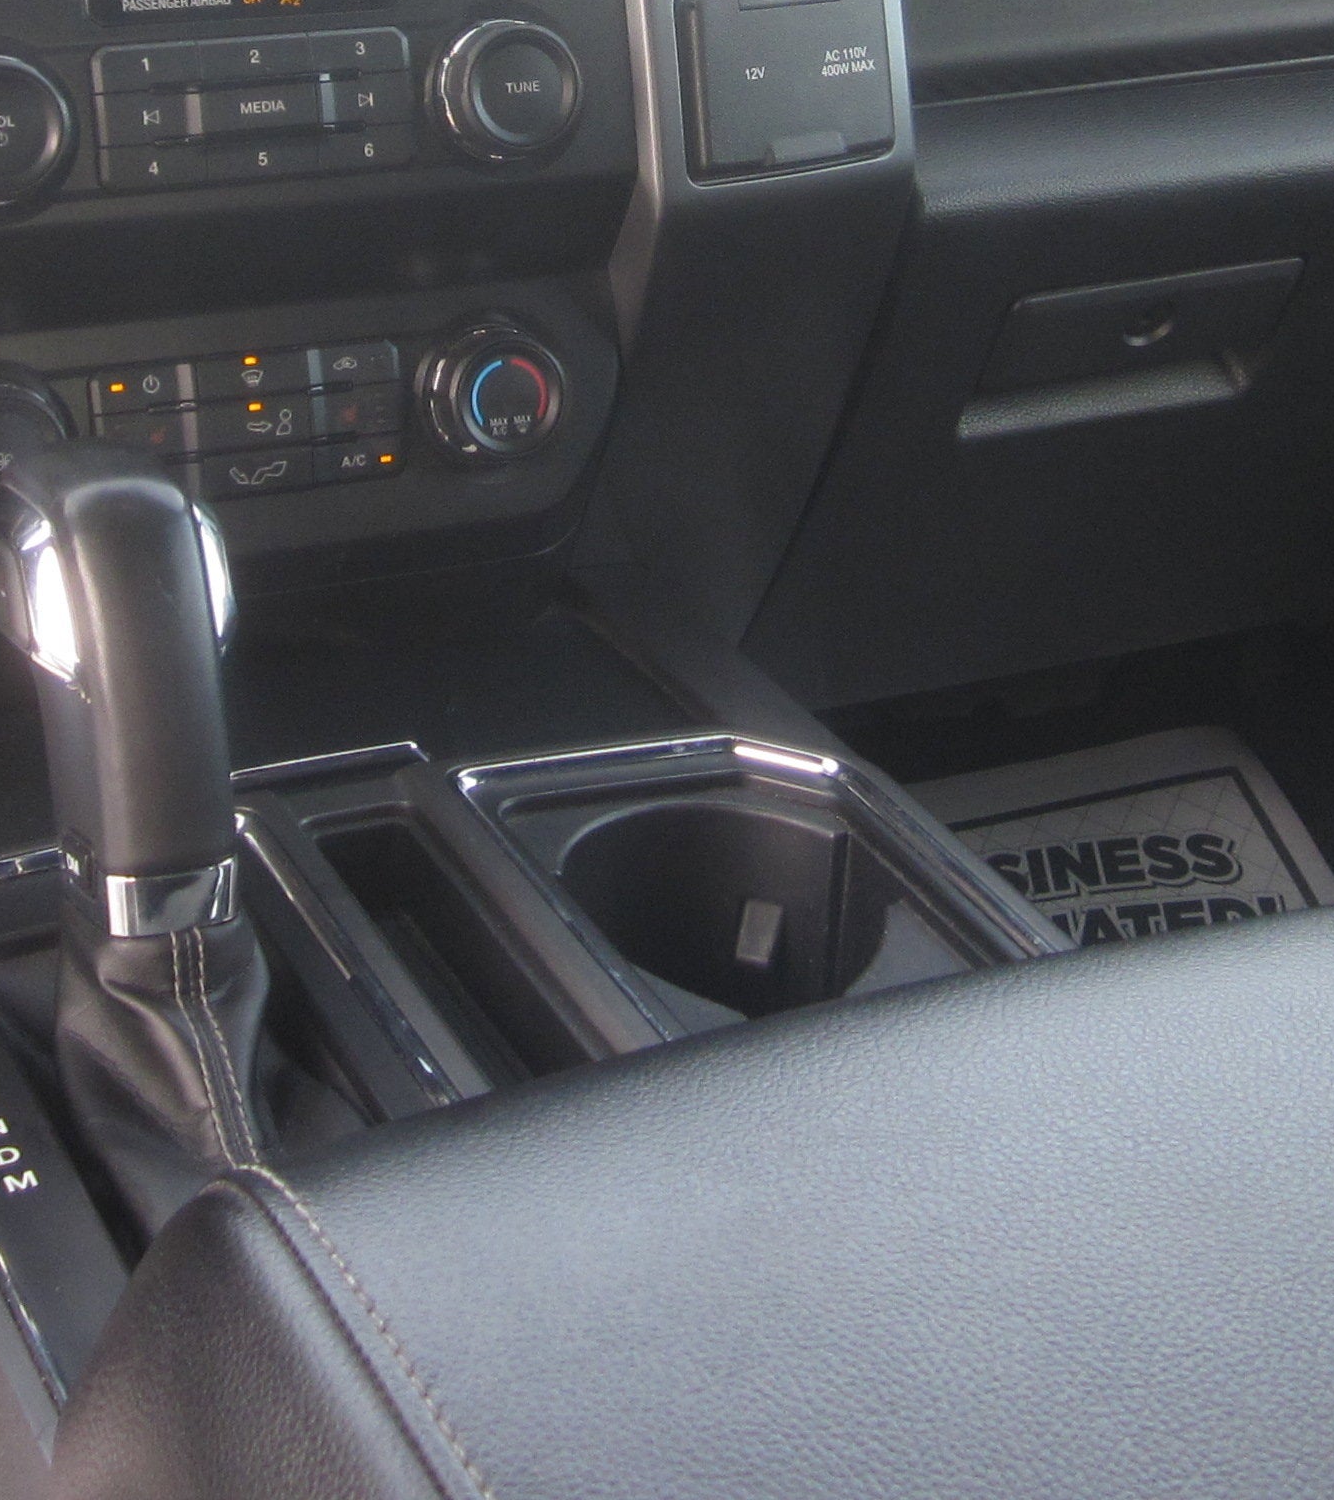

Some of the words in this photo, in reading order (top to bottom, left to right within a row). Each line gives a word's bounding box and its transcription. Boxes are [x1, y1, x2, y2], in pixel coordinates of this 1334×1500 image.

[355, 41, 365, 55] 3
[824, 49, 840, 63] AC
[843, 45, 868, 60] 110V
[142, 57, 150, 71] 1
[250, 50, 260, 64] 2
[745, 66, 766, 80] 12V
[821, 61, 849, 77] 400W
[852, 59, 876, 72] MAX
[505, 80, 541, 94] TUNE
[240, 100, 285, 115] MEDIA
[364, 143, 374, 158] 6
[258, 152, 268, 166] 5
[148, 161, 159, 175] 4
[341, 454, 366, 468] A/C
[3, 1170, 39, 1193] M
